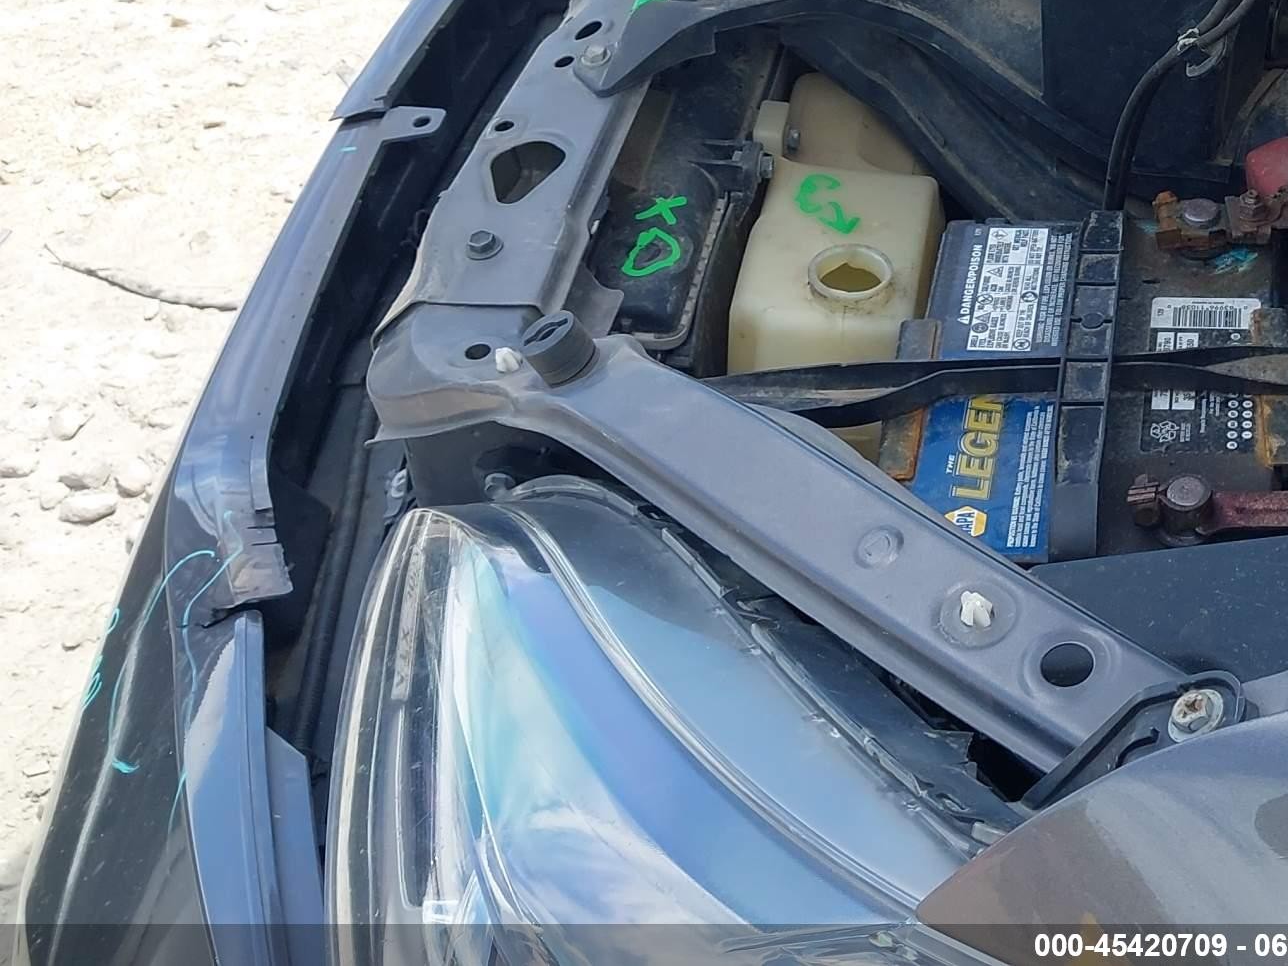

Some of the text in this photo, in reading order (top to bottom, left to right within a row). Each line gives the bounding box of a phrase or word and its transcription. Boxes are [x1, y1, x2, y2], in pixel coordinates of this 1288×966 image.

[959, 244, 982, 314] DANGER/POISON
[946, 454, 955, 474] THE
[949, 397, 1004, 500] LEGEN
[955, 512, 976, 533] APA
